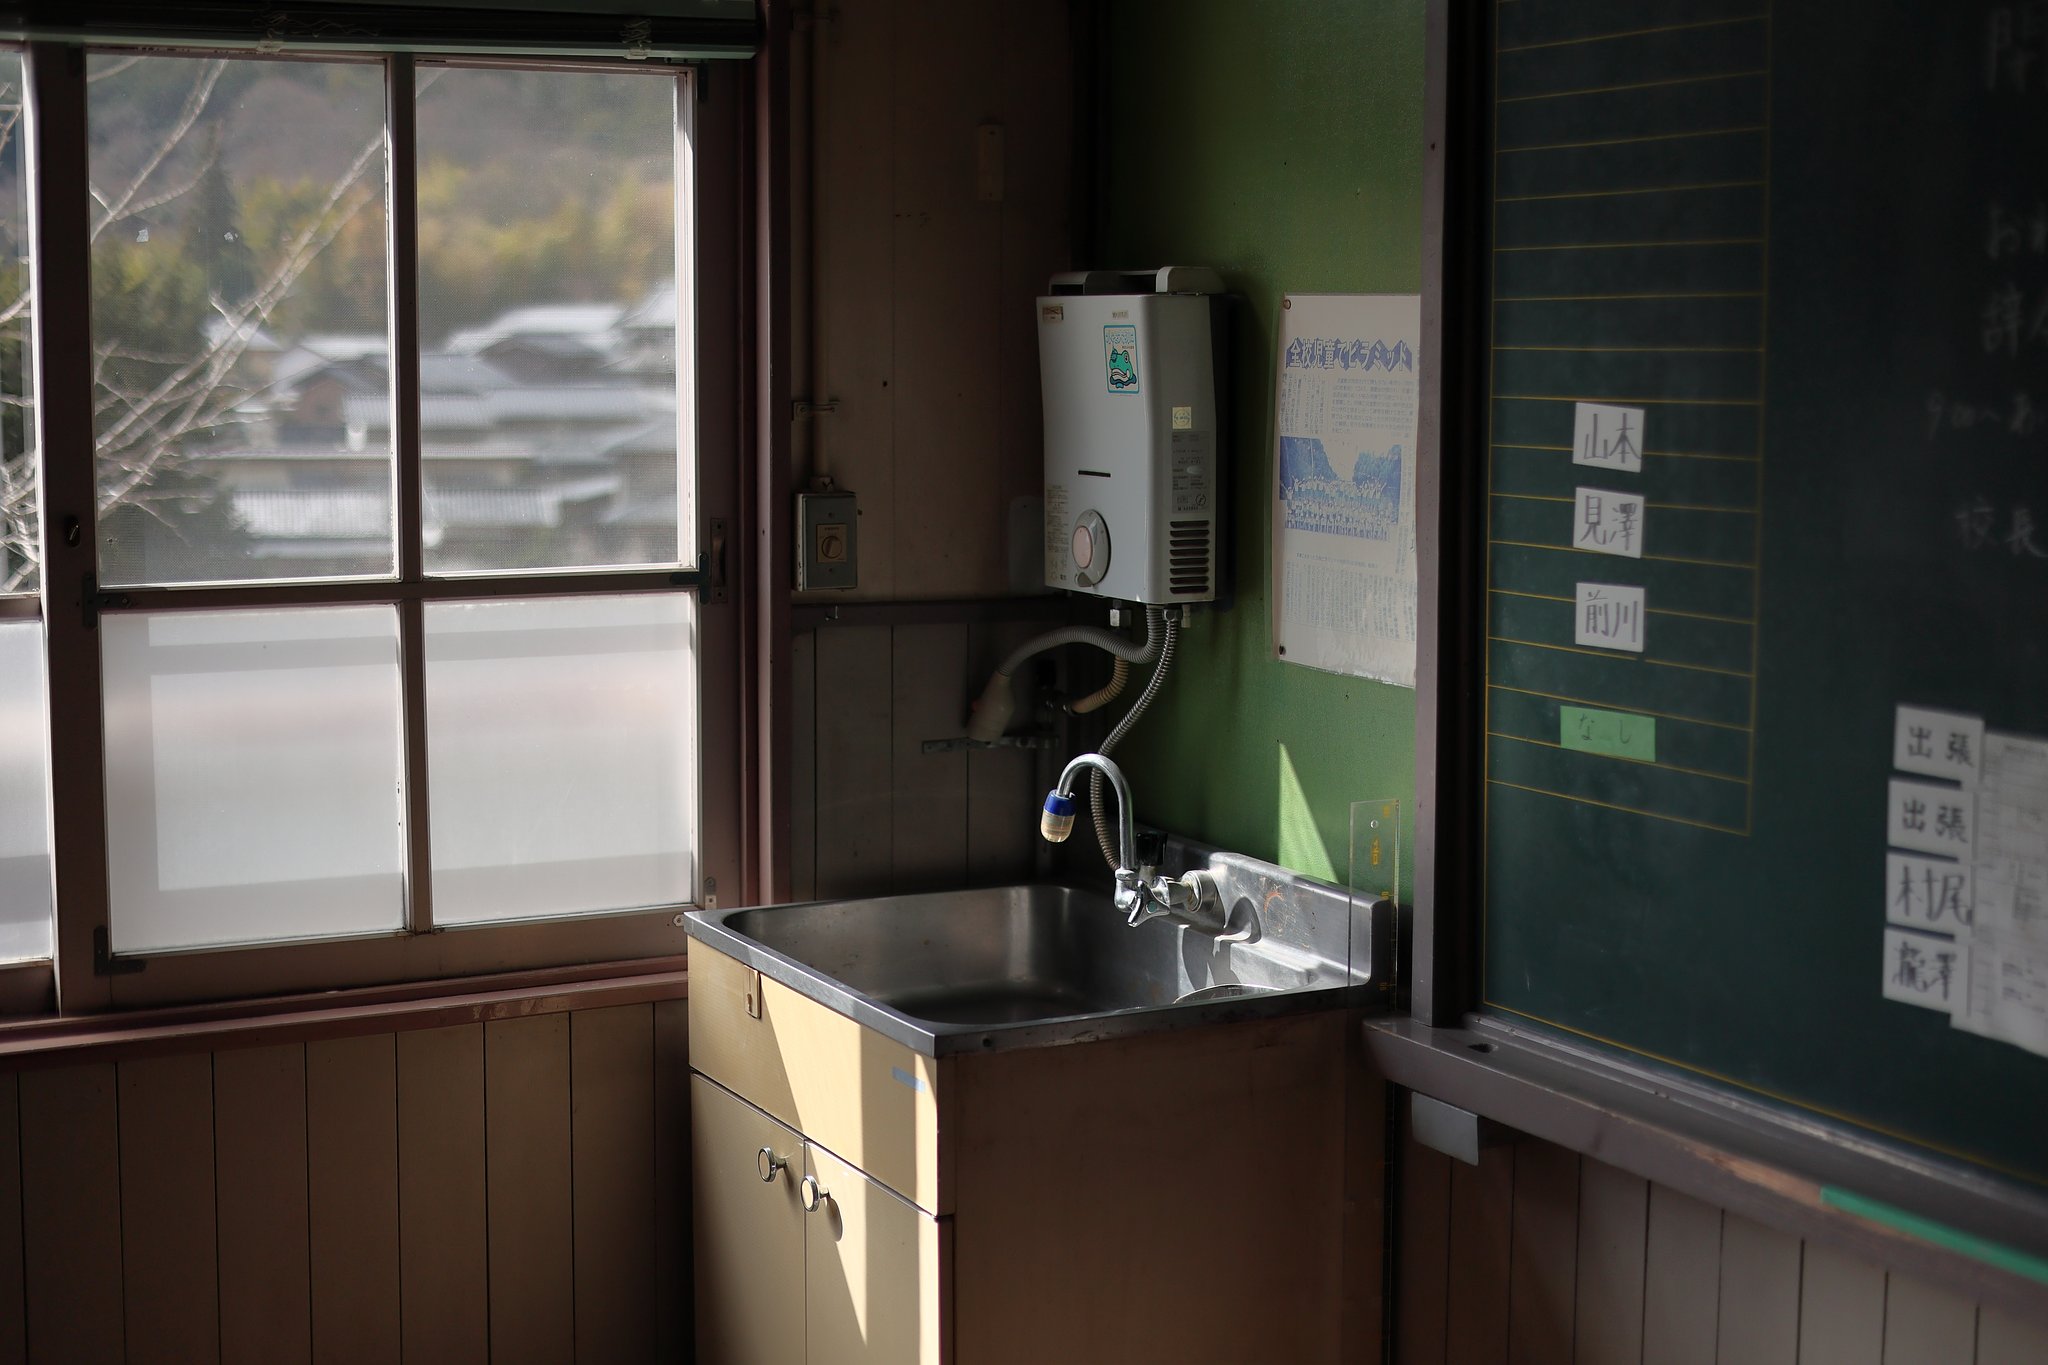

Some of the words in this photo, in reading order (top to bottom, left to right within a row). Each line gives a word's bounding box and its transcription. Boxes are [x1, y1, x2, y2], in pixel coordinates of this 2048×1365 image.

[1287, 338, 1410, 372] 全校児童でピラミッド
[1583, 413, 1642, 464] 山本
[1580, 495, 1638, 551] 見澤
[1585, 590, 1639, 643] 前川
[1578, 712, 1632, 744] なし
[1907, 725, 1975, 769] 出張
[1902, 798, 1969, 844] 出張
